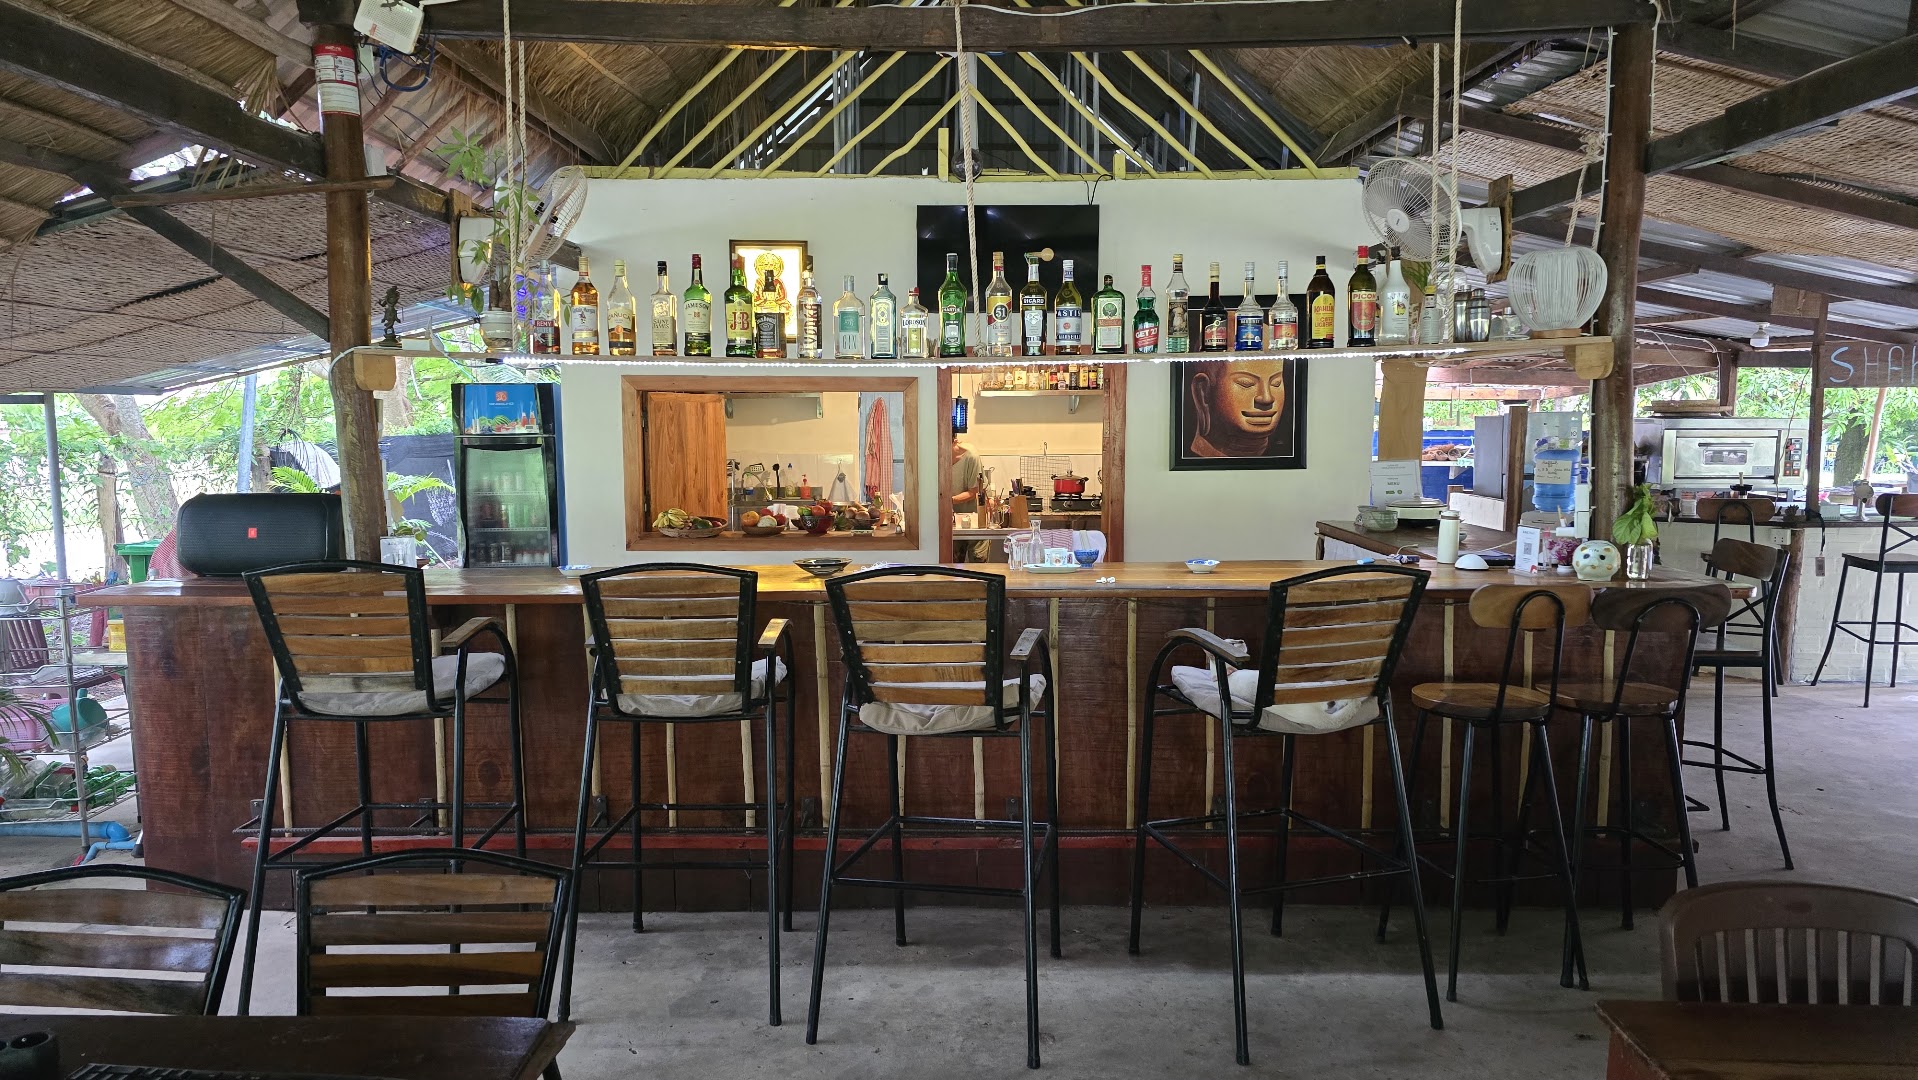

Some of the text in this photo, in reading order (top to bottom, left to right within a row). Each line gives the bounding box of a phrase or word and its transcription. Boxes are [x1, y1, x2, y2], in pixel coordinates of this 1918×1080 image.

[685, 302, 709, 311] JAMESON
[995, 308, 1006, 318] 51
[1136, 329, 1150, 338] GET
[842, 334, 856, 350] GIN
